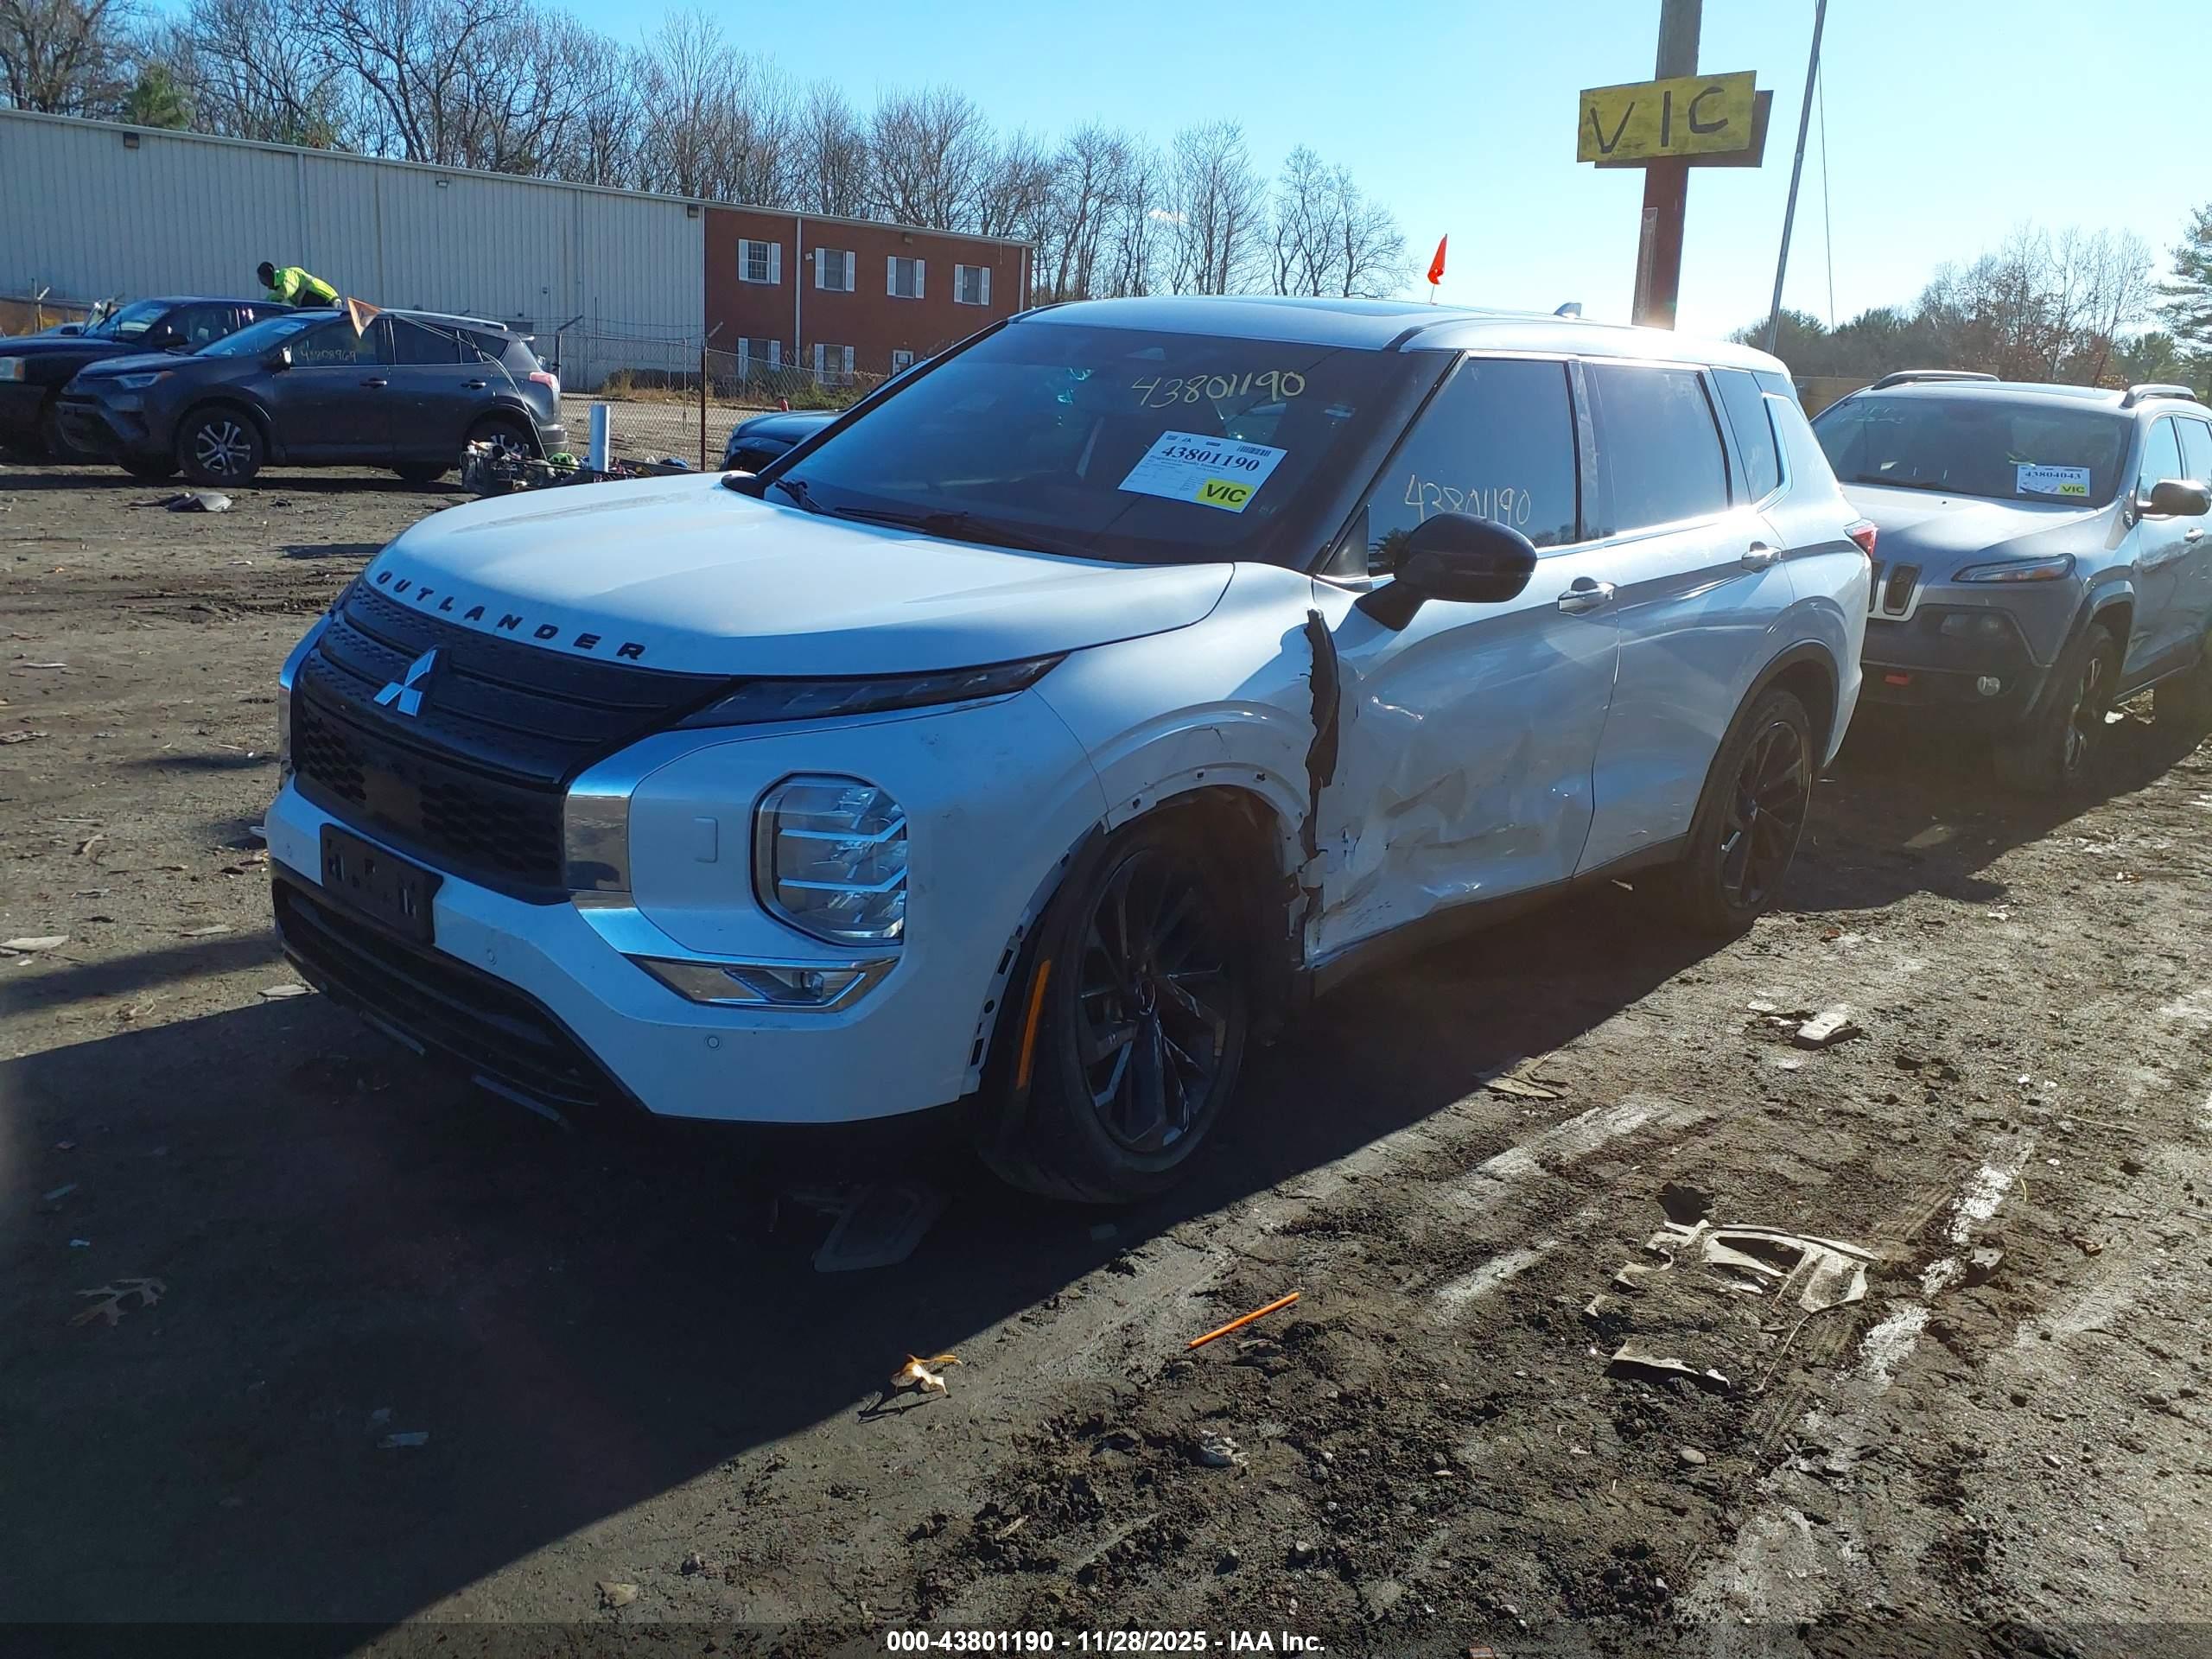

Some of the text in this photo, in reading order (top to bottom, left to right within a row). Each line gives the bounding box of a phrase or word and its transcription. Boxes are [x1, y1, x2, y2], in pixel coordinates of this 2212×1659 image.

[1590, 86, 1729, 153] VIC
[1131, 371, 1306, 408] 43801190
[1161, 445, 1260, 472] 43801190
[2025, 471, 2082, 480] 43804043
[1207, 484, 1246, 503] VIC
[376, 570, 646, 660] OUTLANDER
